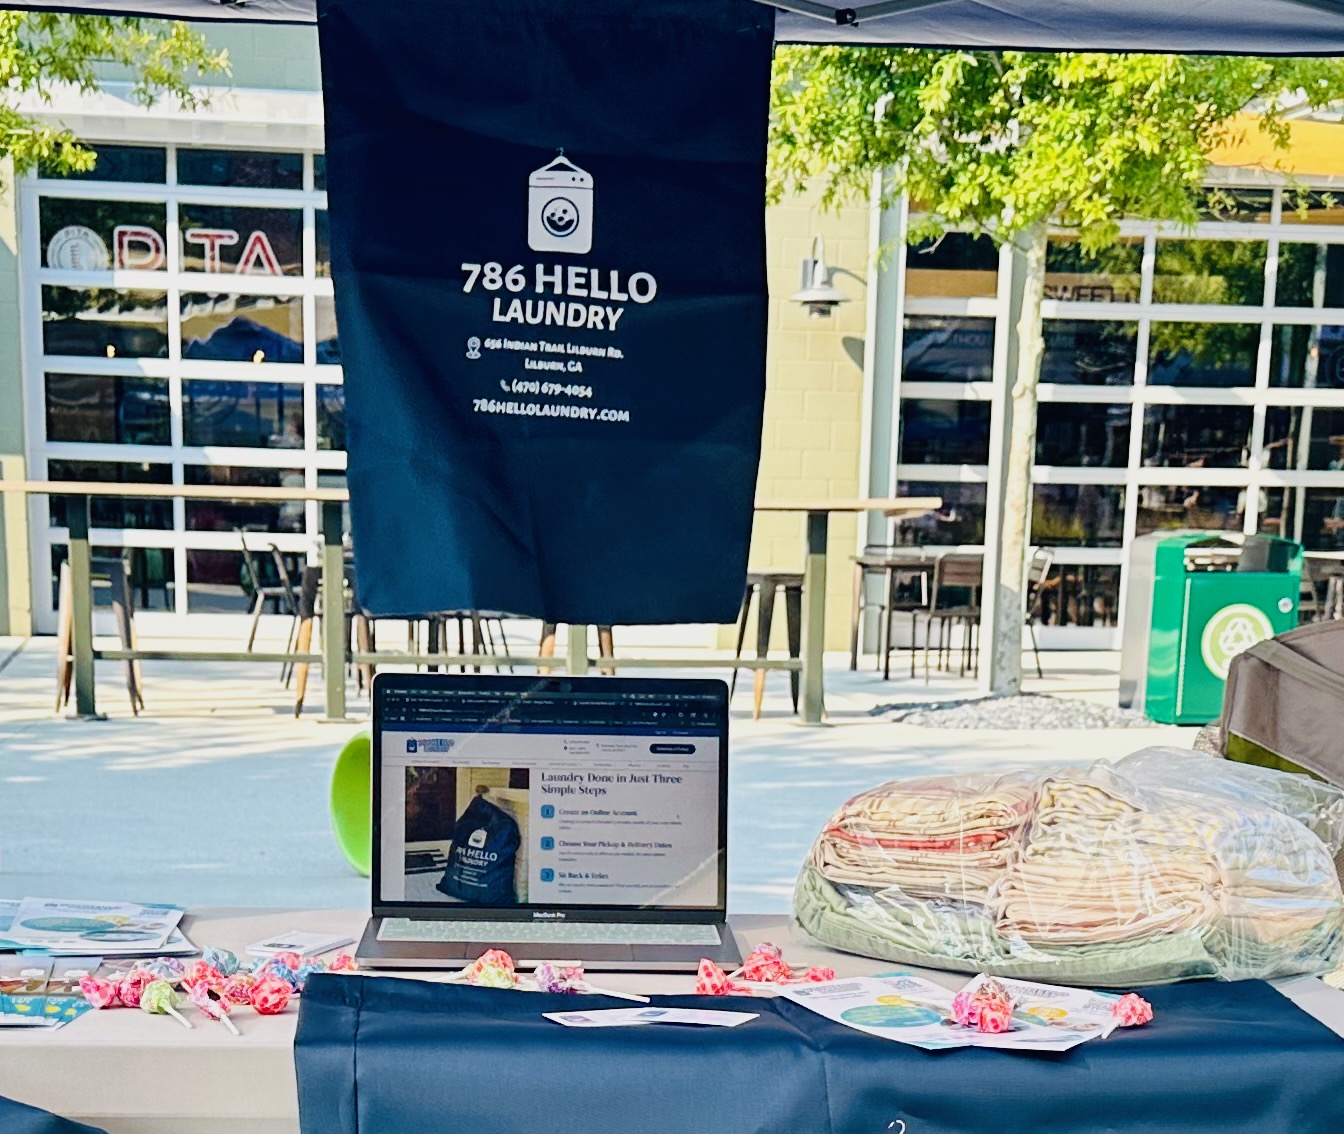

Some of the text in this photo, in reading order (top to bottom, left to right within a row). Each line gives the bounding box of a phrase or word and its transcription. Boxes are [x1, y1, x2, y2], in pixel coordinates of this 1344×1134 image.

[113, 225, 283, 275] PTA
[461, 262, 657, 304] 786 HELLO
[492, 297, 624, 331] LAUNDRY
[484, 338, 624, 359] 656 INDIAN TRAIL LILBURN RD.
[525, 358, 583, 373] LILBURN, GA
[512, 379, 593, 398] (470) 679-4054
[473, 398, 630, 422] 786HELLOLAUNDRY.COM
[541, 772, 683, 784] Laundry Done in Just Three
[541, 784, 607, 797] Simple Steps
[467, 848, 498, 862] HELLO
[533, 911, 566, 919] MacBook Pro
